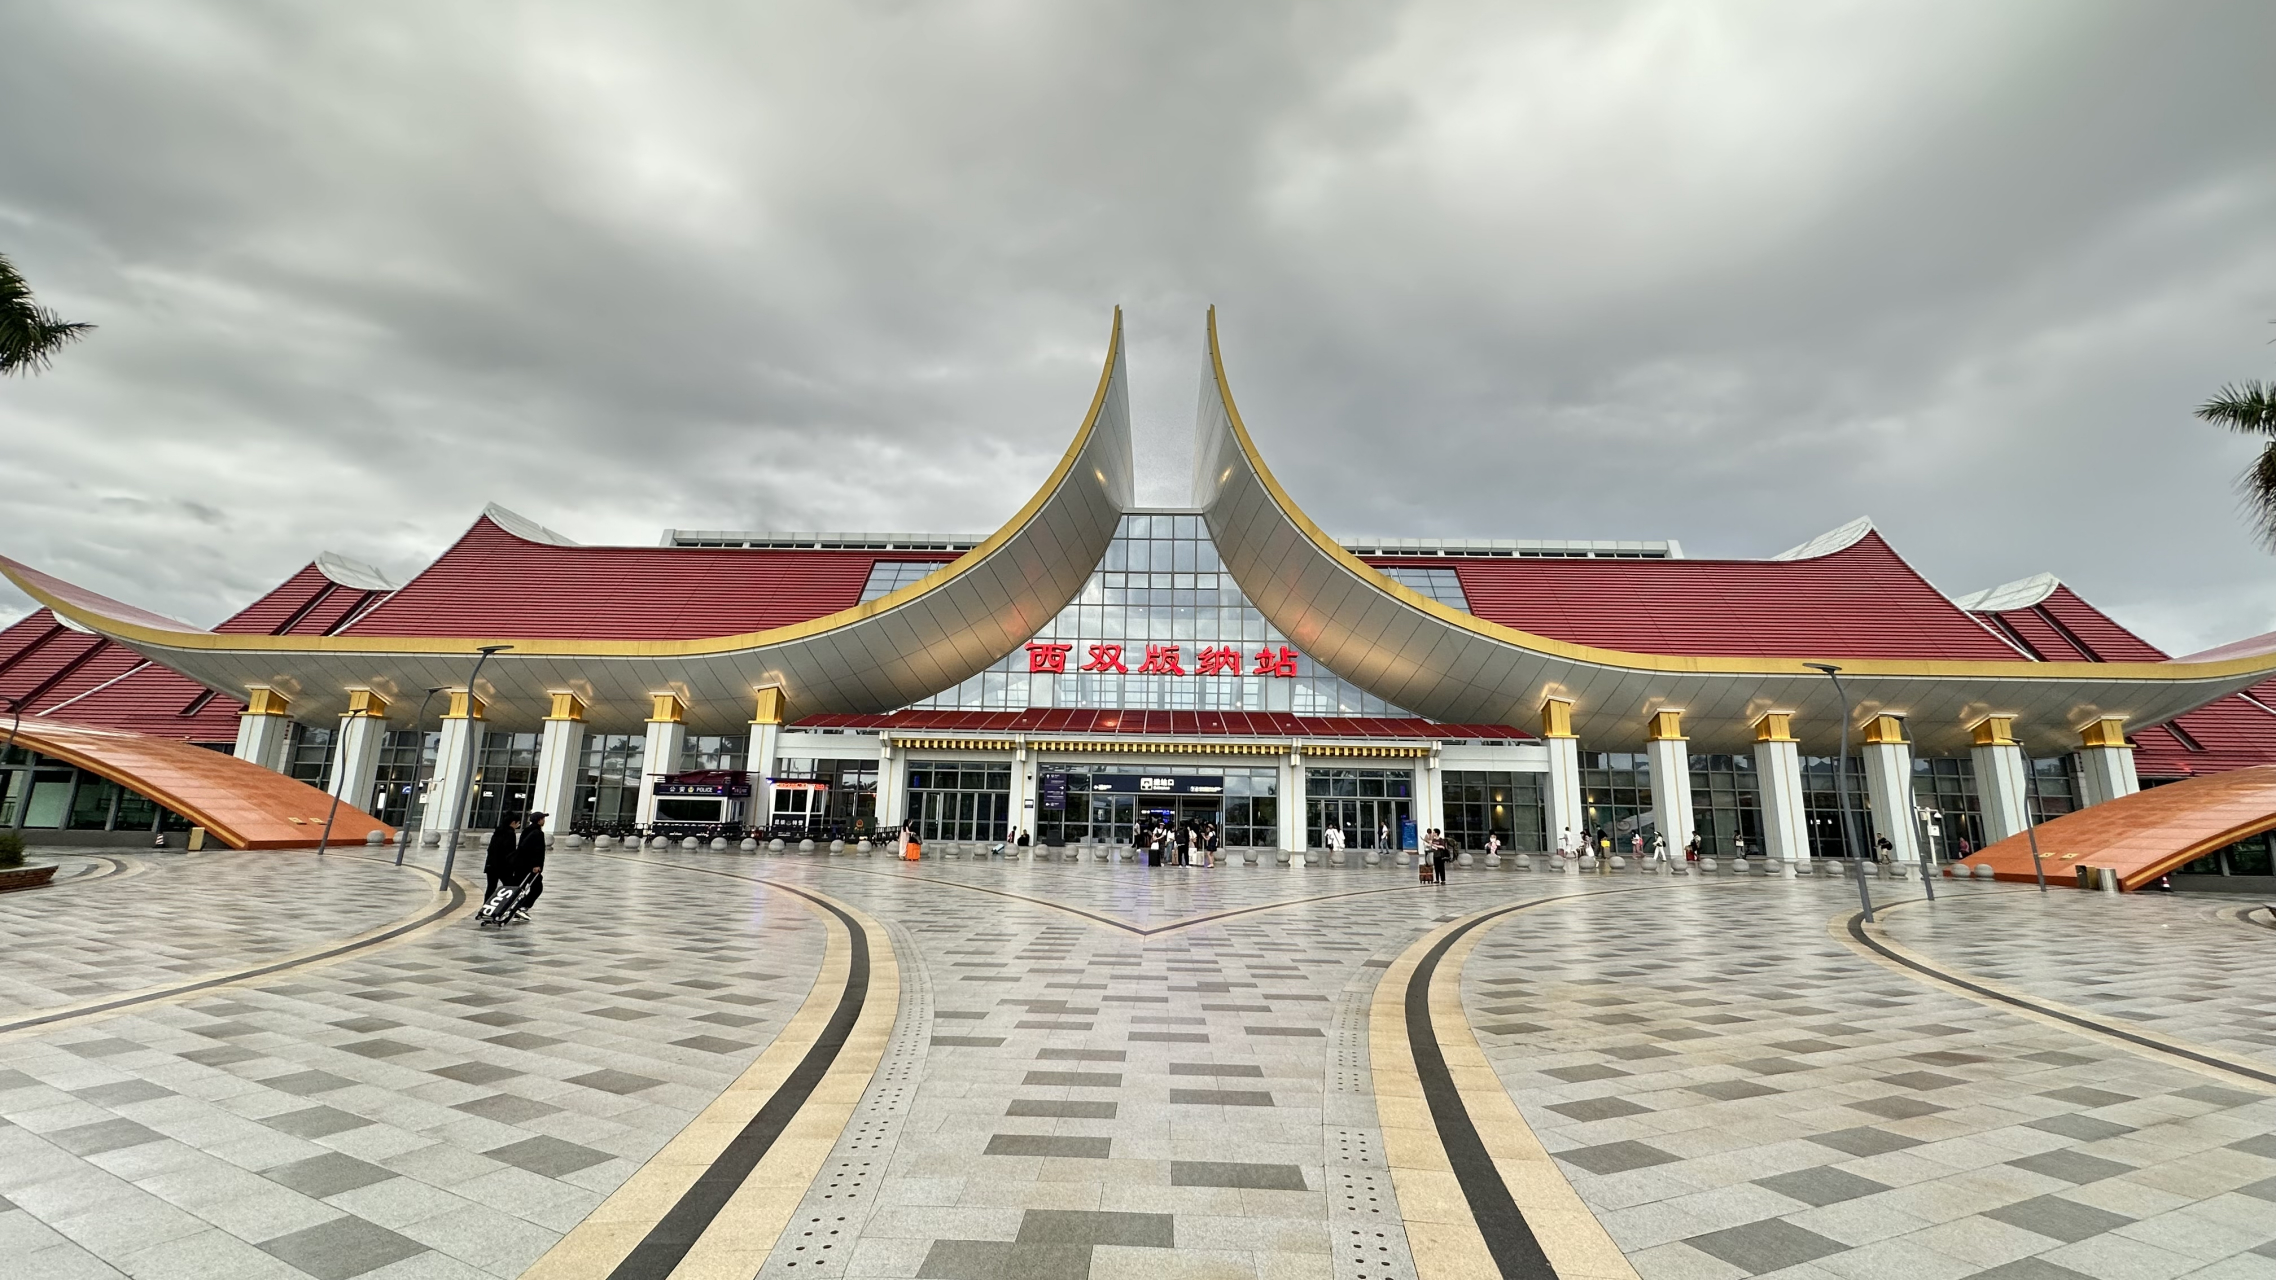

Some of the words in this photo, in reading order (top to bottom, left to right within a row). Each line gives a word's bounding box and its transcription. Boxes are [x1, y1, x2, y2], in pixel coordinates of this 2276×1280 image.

[1025, 642, 1299, 678] 西双版纳站
